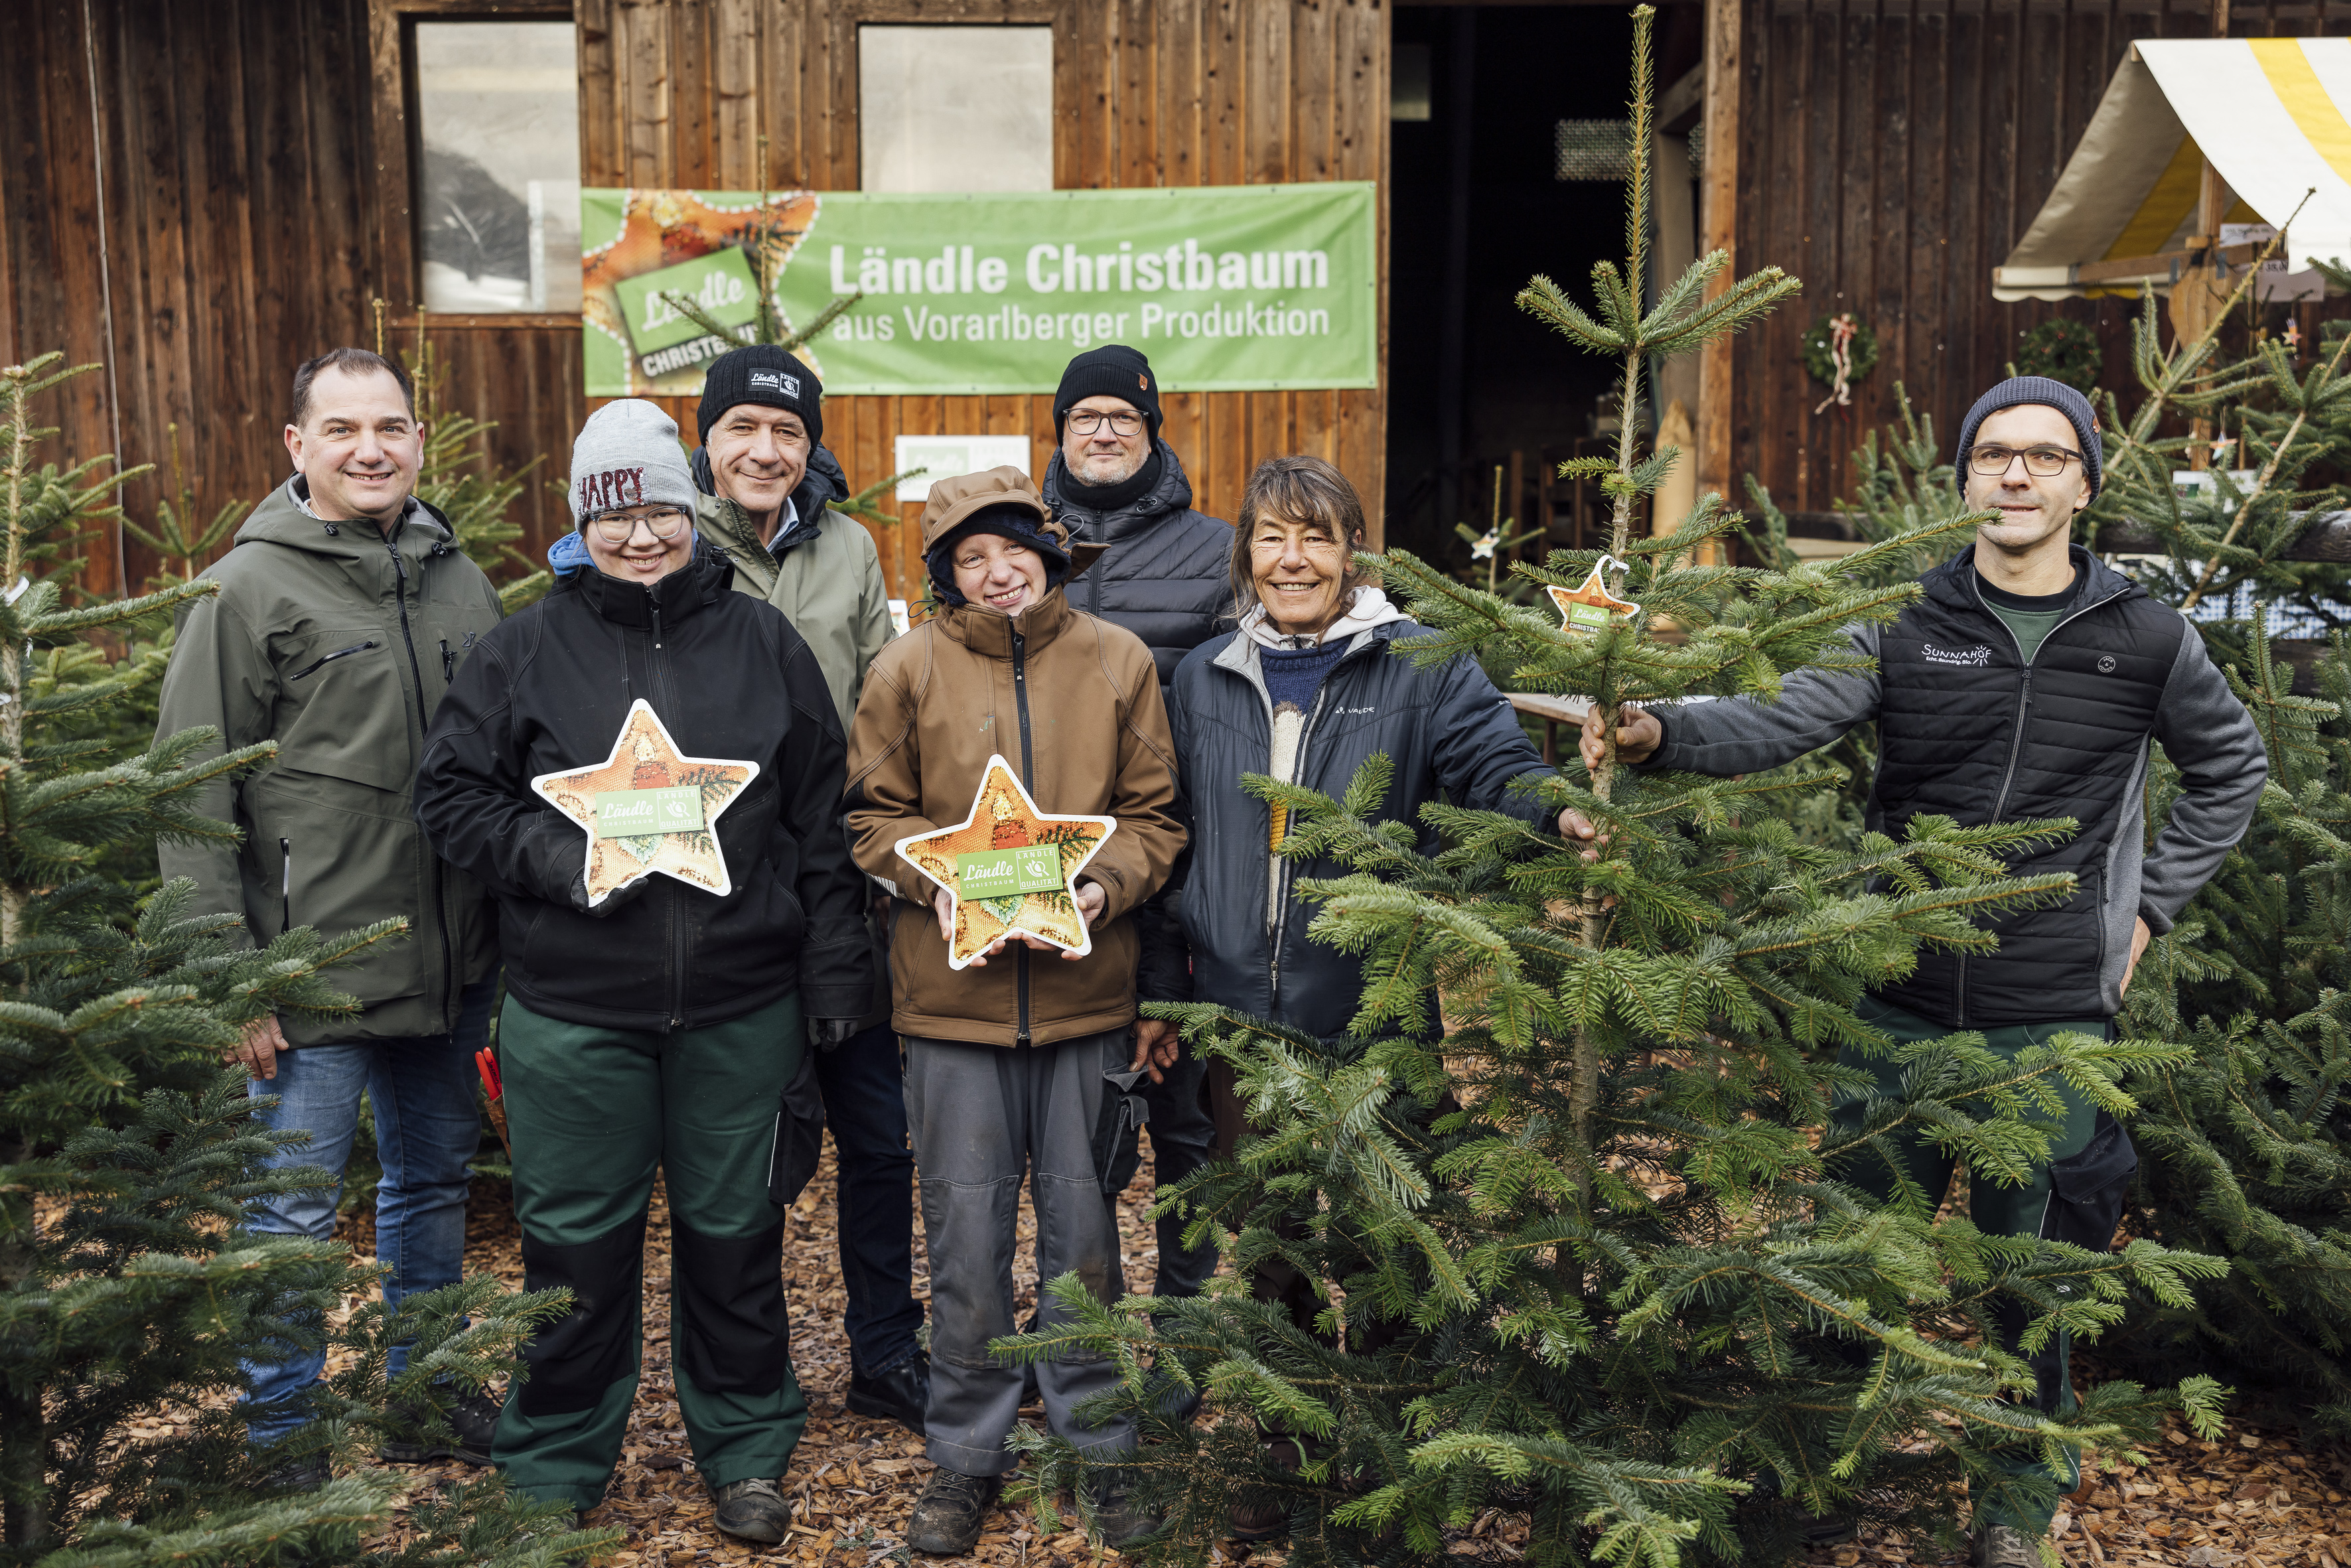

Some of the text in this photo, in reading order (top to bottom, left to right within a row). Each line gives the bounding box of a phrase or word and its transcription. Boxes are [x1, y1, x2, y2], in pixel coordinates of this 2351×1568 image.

[830, 239, 1327, 295] Ländle Christbaum
[831, 300, 1328, 348] aus Vorarlberger Produktion
[751, 373, 780, 384] Ländle
[577, 467, 644, 514] HAPPY
[1573, 608, 1605, 622] Ländle
[1569, 622, 1601, 634] CHRISTBA
[658, 790, 695, 800] LÄNDLE
[601, 800, 654, 820] Ländle
[604, 818, 654, 827] CHRISTBAUM
[661, 819, 697, 827] QUALITÄT
[1017, 849, 1054, 859] LÄNDLE
[963, 861, 1015, 882] Ländle
[965, 879, 1014, 889] CHRISTBAUM
[1021, 878, 1056, 888] QUALITÄT
